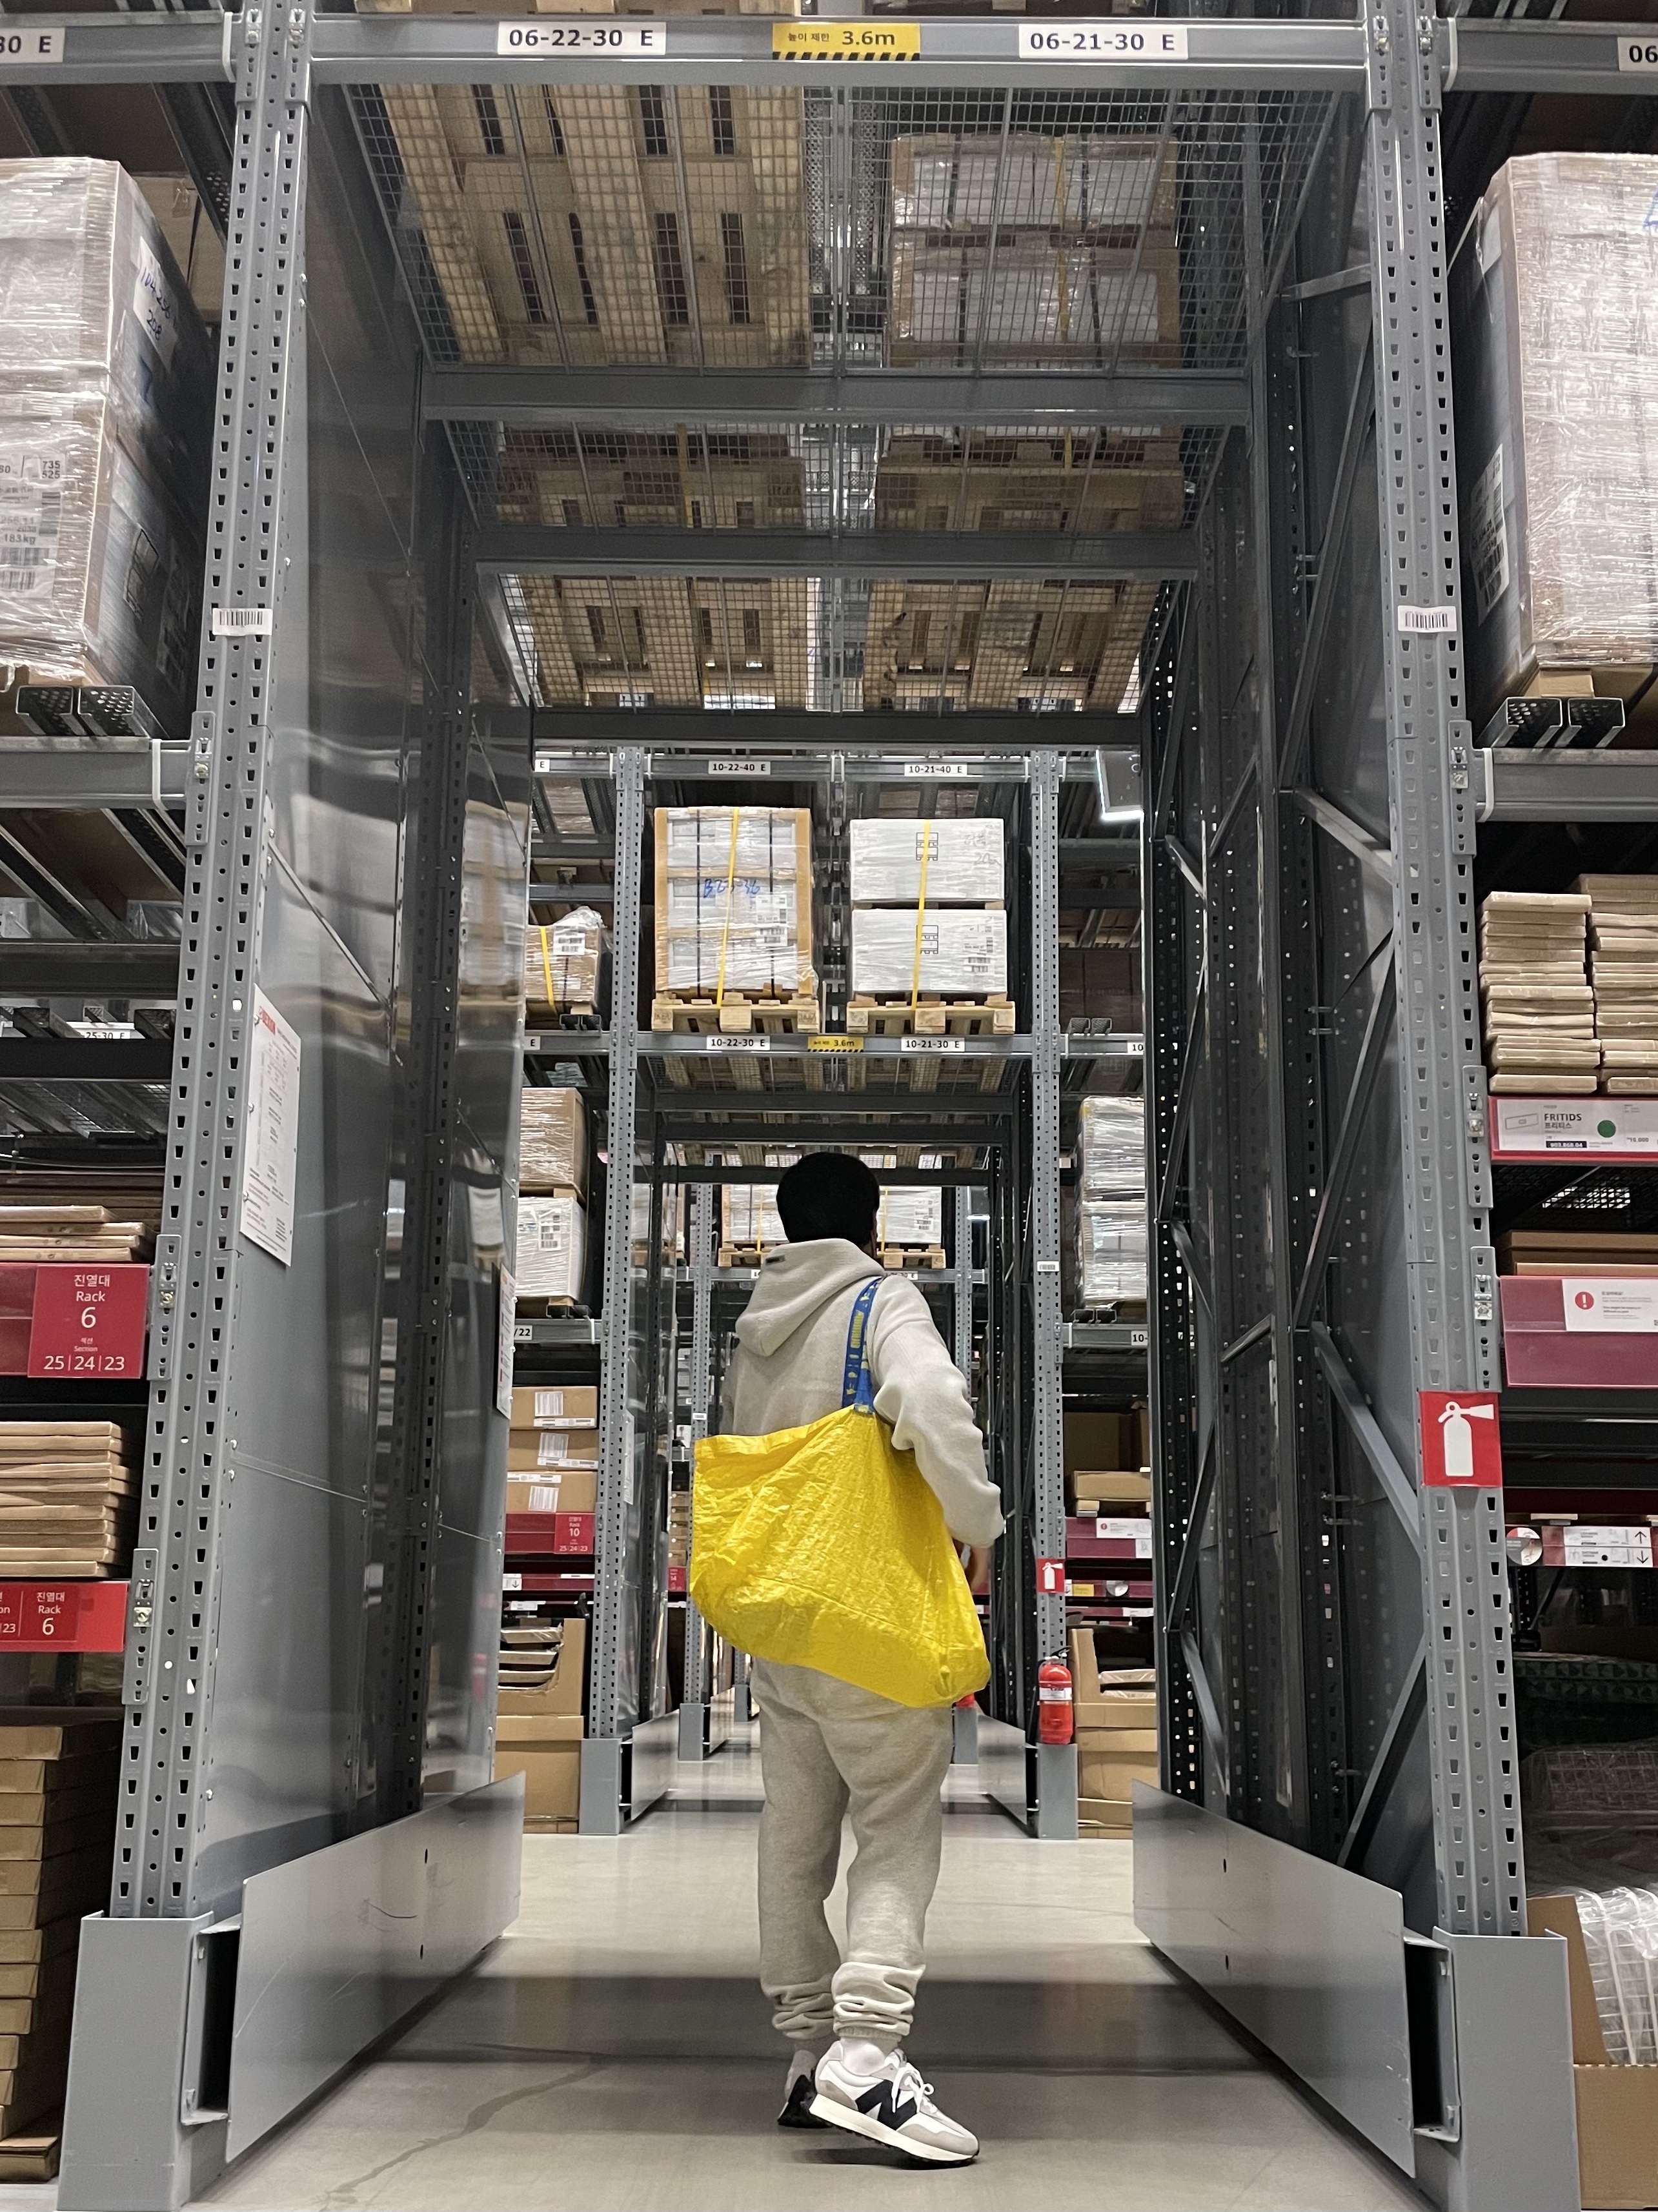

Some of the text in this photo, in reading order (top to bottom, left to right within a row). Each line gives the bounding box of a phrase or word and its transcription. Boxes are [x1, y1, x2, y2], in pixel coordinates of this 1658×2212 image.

[39, 36, 51, 53] E
[509, 29, 653, 46] 06-22-30 E
[842, 30, 895, 45] 3.6m
[1030, 33, 1175, 50] 06-21-30 E
[43, 460, 61, 469] 735
[74, 1274, 110, 1287] 진열대
[76, 1291, 106, 1302] Rack
[81, 1306, 96, 1328] 6
[44, 1355, 125, 1371] 25 24 23
[569, 1528, 580, 1537] 10
[37, 1592, 65, 1602] 진열대
[38, 1605, 61, 1614] Rack
[42, 1617, 54, 1635] 6
